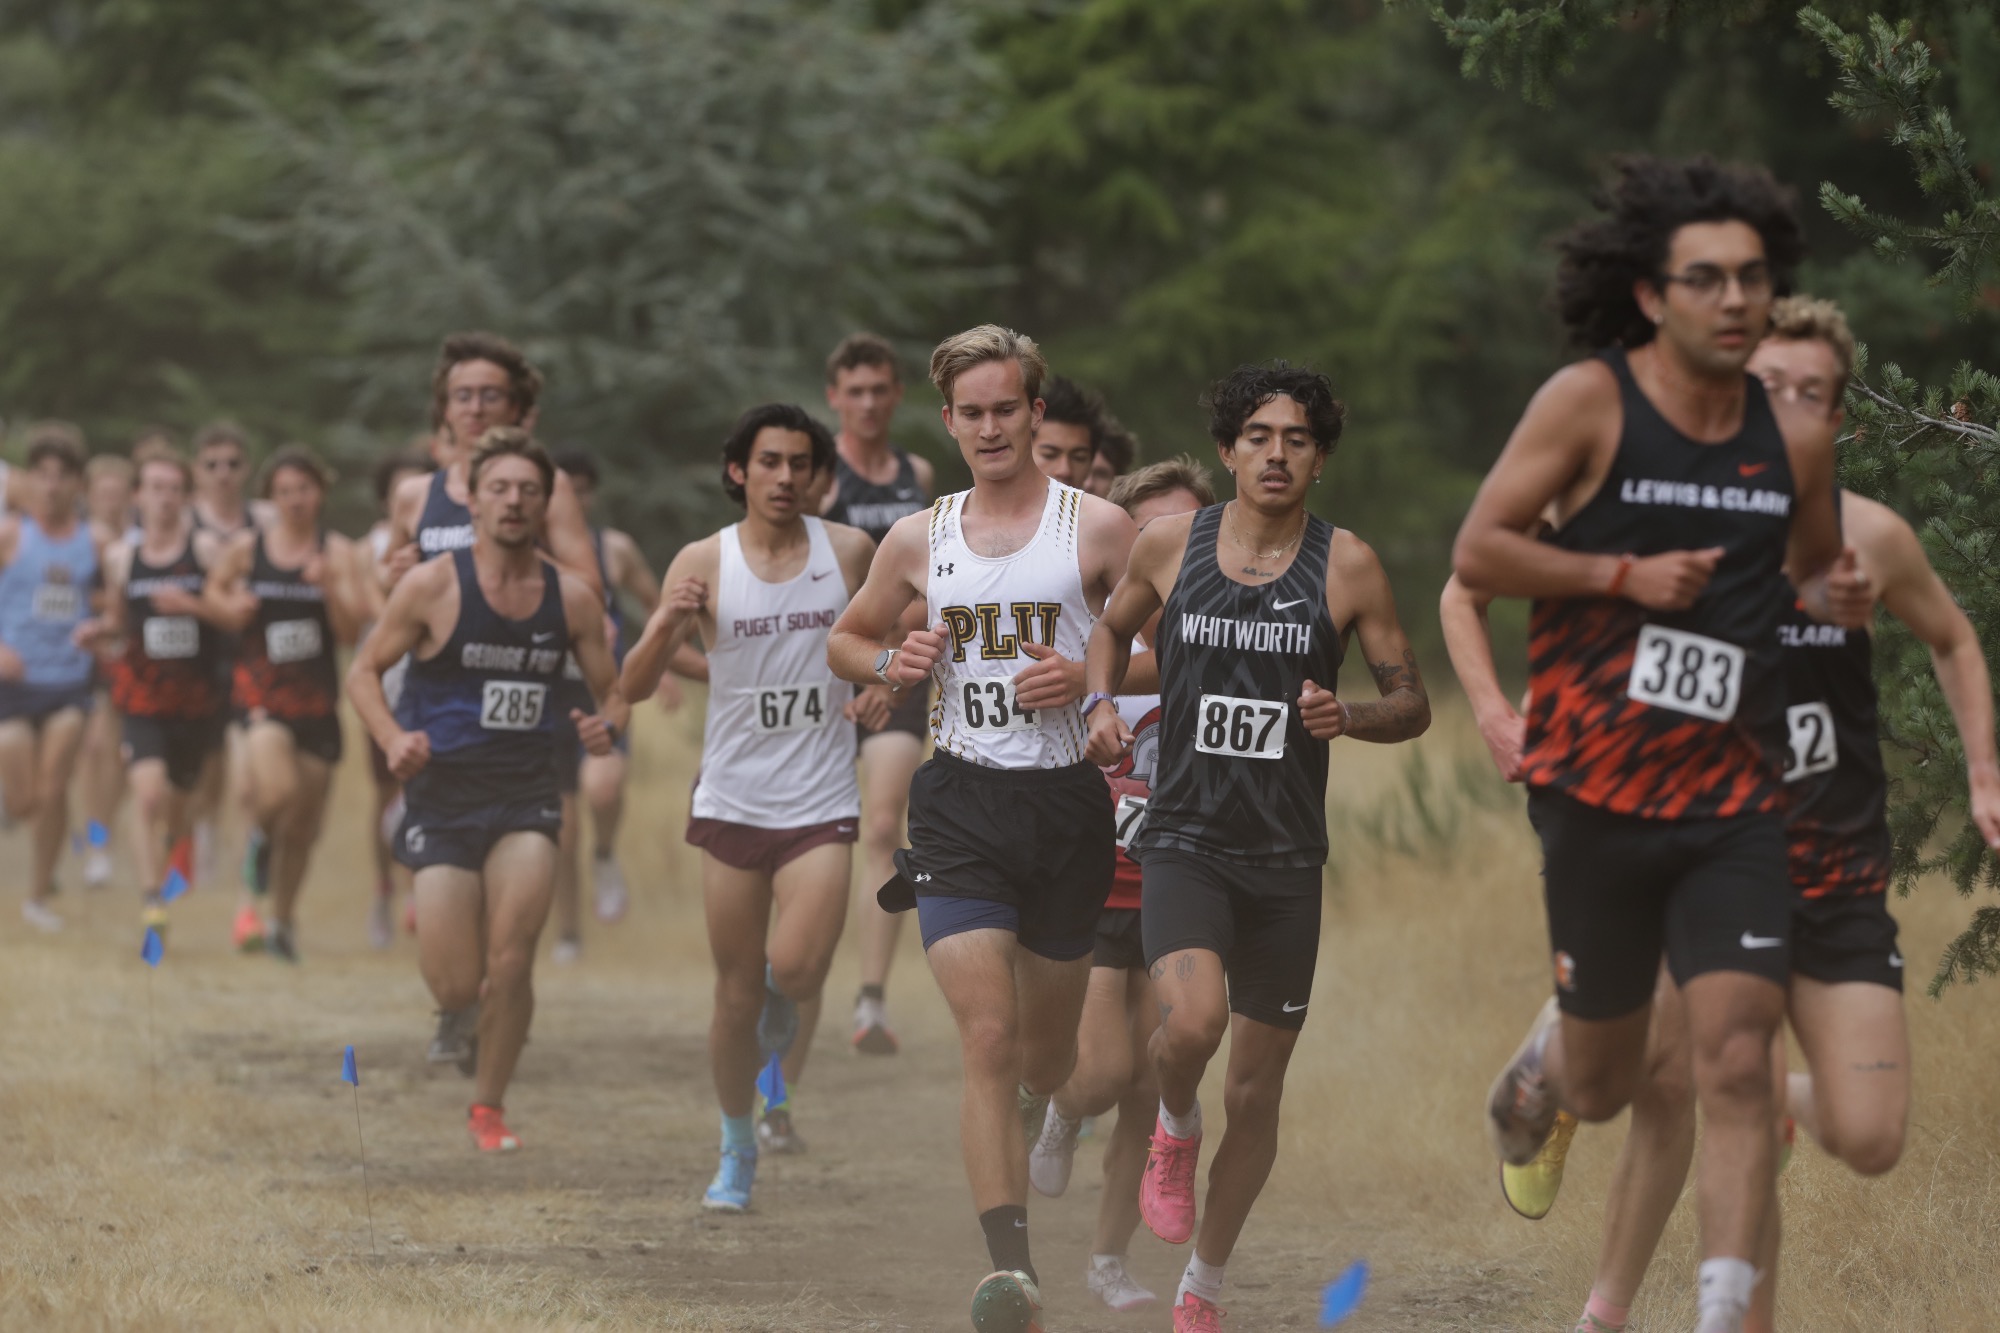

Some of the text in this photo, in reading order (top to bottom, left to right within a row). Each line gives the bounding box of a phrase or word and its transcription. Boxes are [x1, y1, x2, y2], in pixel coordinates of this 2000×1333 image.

[733, 609, 835, 638] PUGET SOUND
[941, 602, 1061, 662] PLU
[1182, 613, 1310, 655] WHITWORTH
[1643, 637, 1732, 709] 383
[487, 688, 540, 724] 285
[760, 687, 823, 728] 674
[1203, 701, 1282, 753] 867
